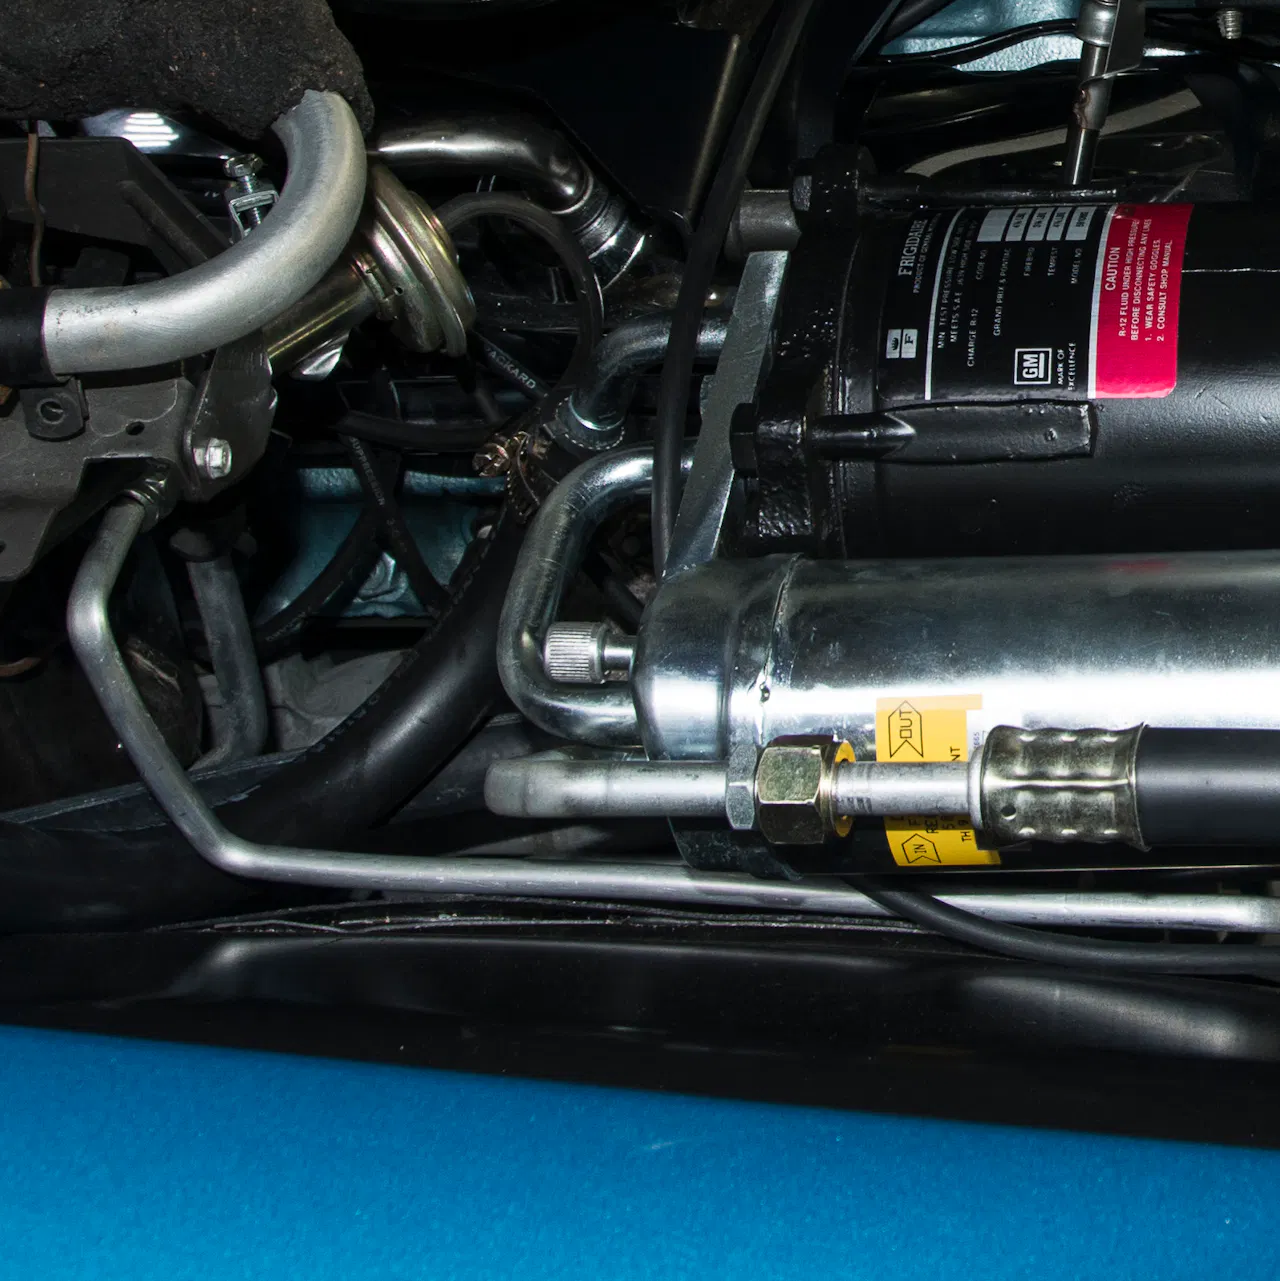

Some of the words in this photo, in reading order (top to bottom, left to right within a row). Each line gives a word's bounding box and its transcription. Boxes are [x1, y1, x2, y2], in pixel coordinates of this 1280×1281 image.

[898, 218, 928, 276] FRIGIDAIRE
[1140, 232, 1148, 245] ANY
[1000, 248, 1012, 276] PONTIAC
[1047, 247, 1059, 276] TEMPEST
[1105, 247, 1121, 290] CAUTION
[1125, 248, 1134, 264] HIGH
[1070, 260, 1082, 284] MODEL
[1122, 266, 1132, 290] UNDER
[1132, 246, 1147, 304] DISCONNECTING
[1160, 268, 1169, 289] SHOP
[996, 286, 1006, 303] PRIX
[1147, 273, 1157, 301] SAFETY
[939, 306, 948, 326] TEST
[1120, 292, 1129, 316] FLUID
[1145, 304, 1154, 329] WEAR
[1157, 291, 1167, 329] CONSULT
[970, 308, 979, 326] R-12
[992, 305, 1003, 336] GRAND
[1118, 317, 1127, 337] R-12
[1130, 306, 1140, 341] BEFORE
[904, 333, 914, 345] F
[967, 329, 977, 367] CHARGE
[1022, 353, 1039, 379] GM
[1057, 349, 1065, 360] OF
[1067, 342, 1076, 390] EXCELLENCE
[899, 709, 913, 739] OUT
[914, 843, 927, 854] IN
